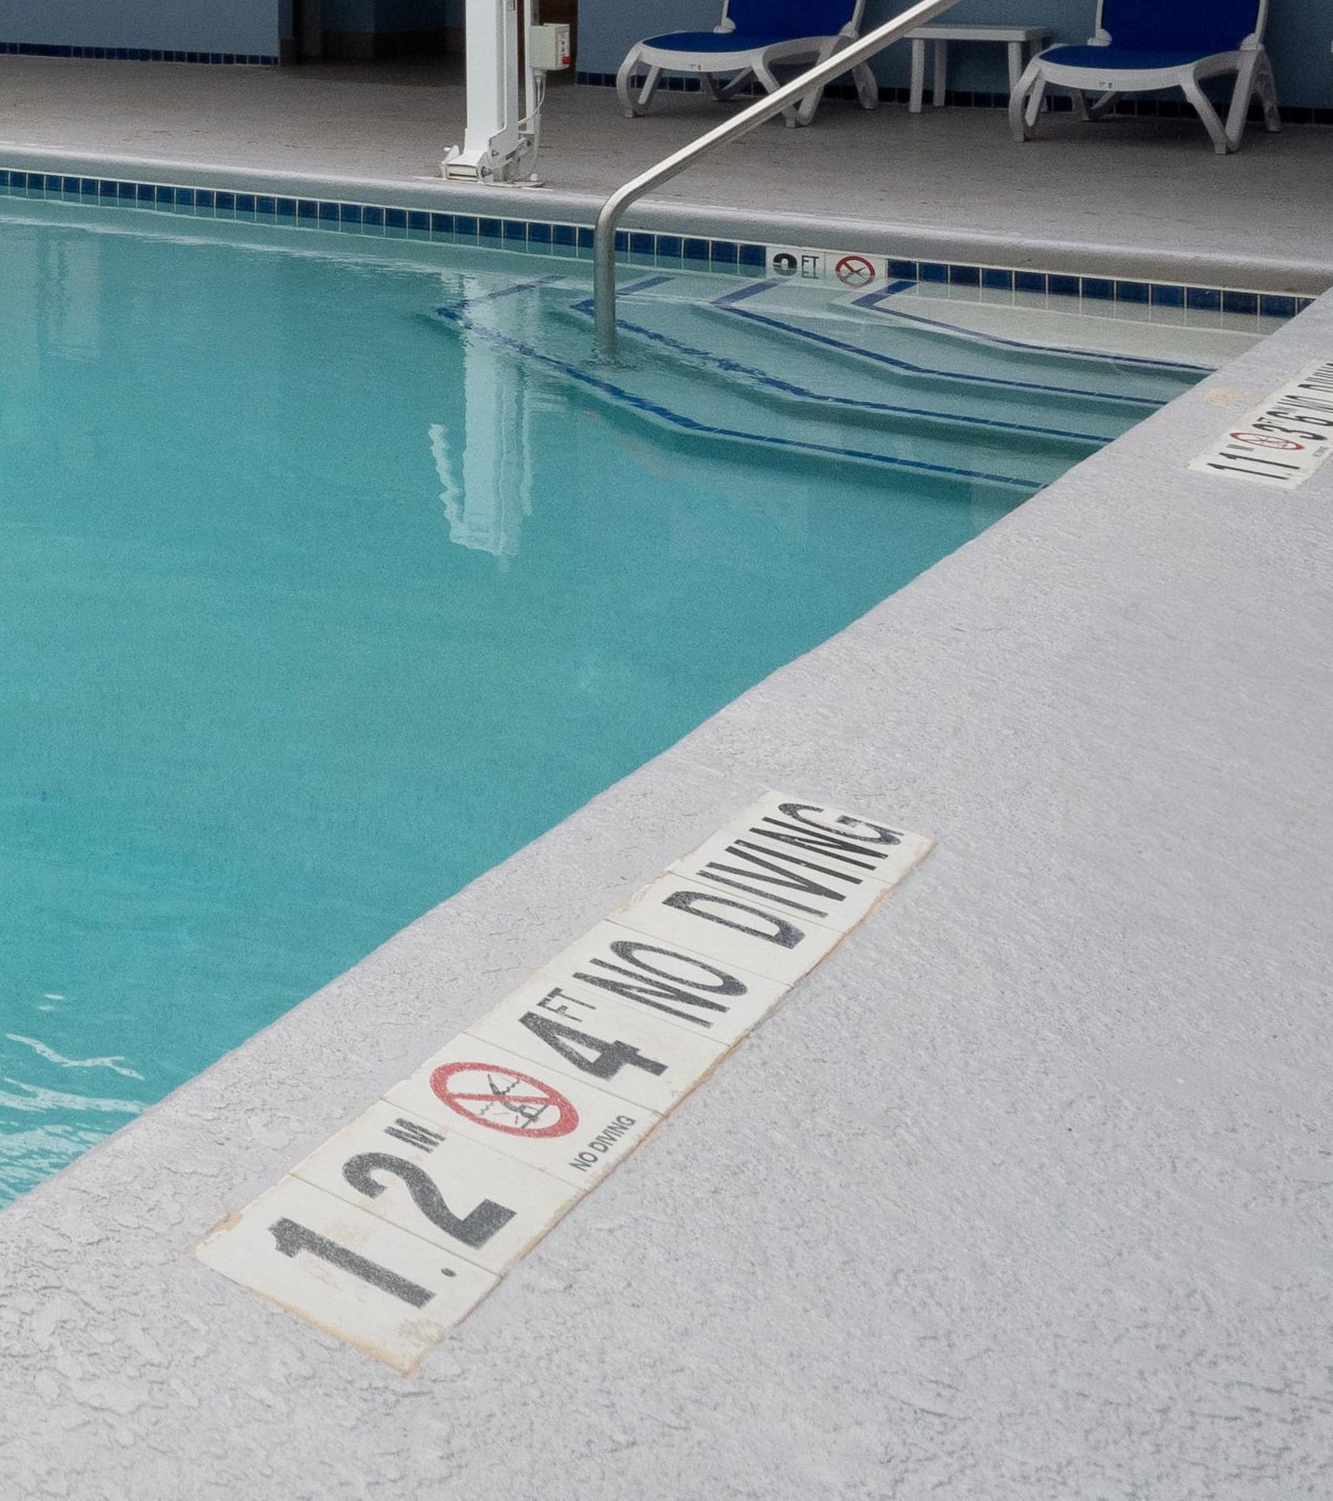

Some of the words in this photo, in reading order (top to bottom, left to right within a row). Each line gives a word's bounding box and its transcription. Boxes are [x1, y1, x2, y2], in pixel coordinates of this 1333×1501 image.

[572, 939, 749, 1030] NO
[661, 802, 905, 950] DIVING
[569, 1142, 598, 1173] NO
[592, 1114, 636, 1153] DIVING
